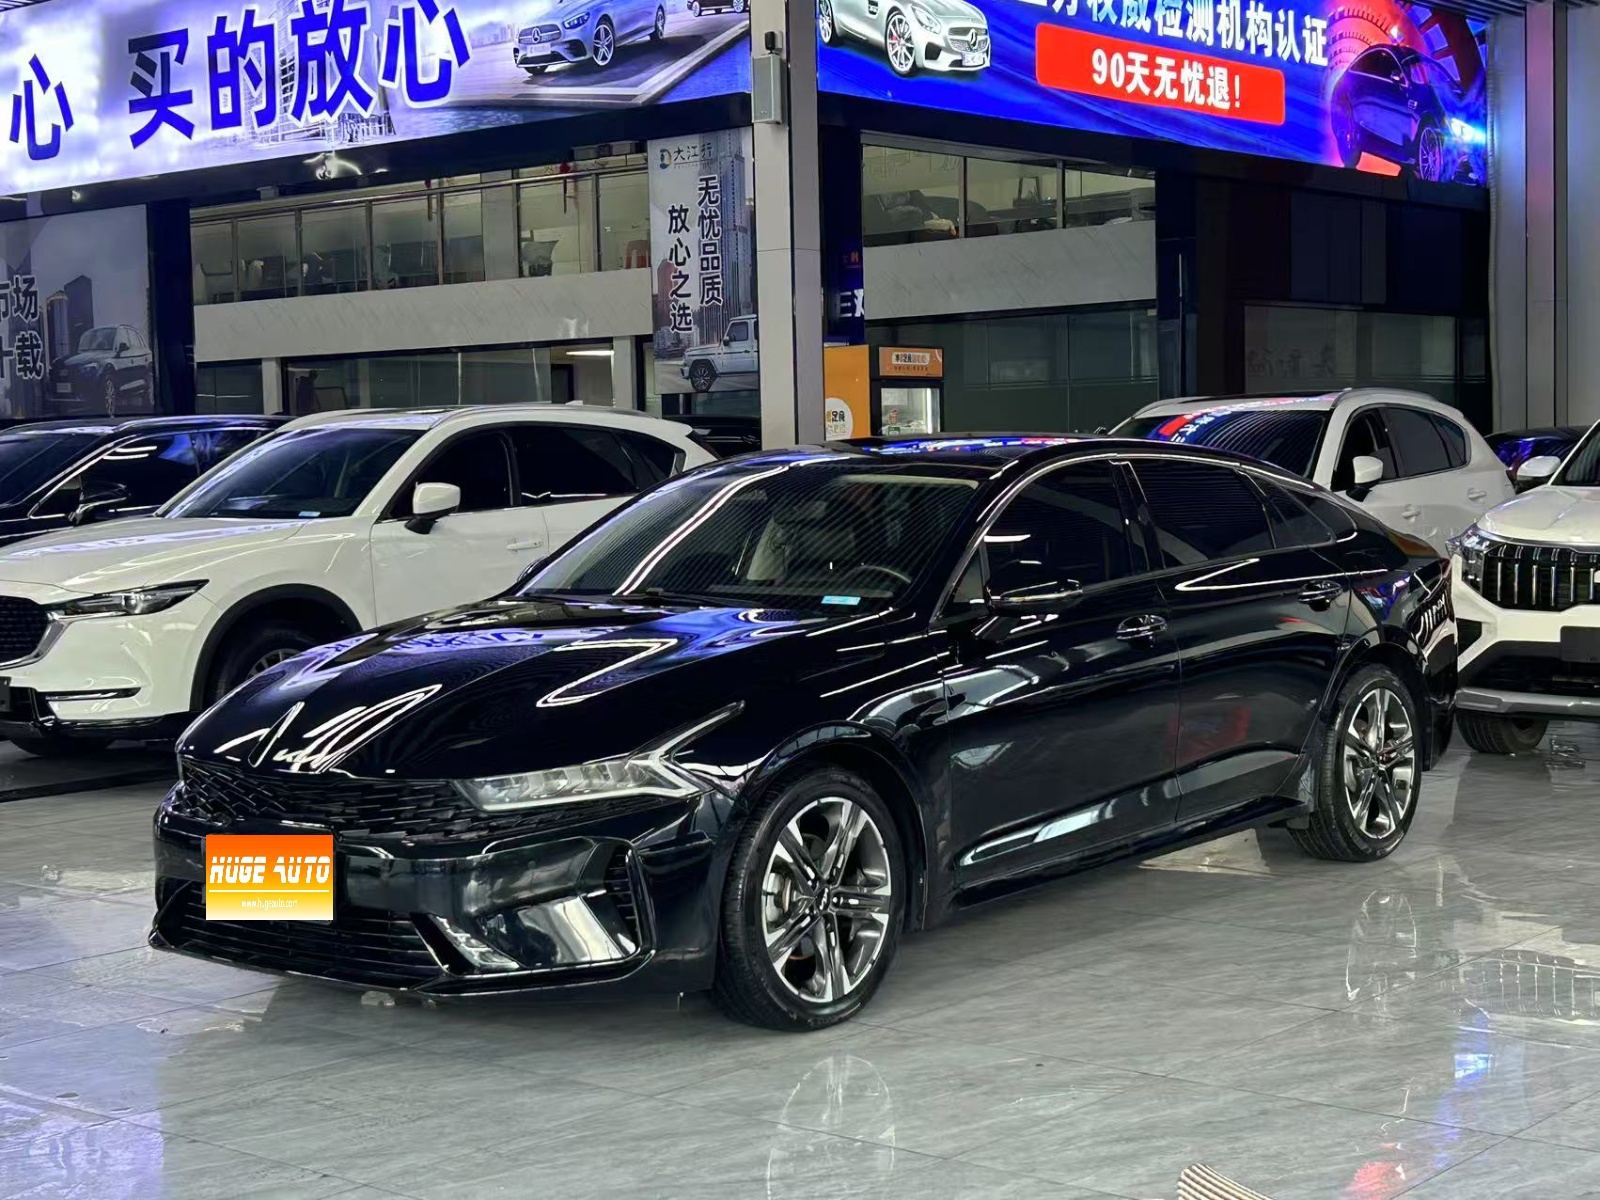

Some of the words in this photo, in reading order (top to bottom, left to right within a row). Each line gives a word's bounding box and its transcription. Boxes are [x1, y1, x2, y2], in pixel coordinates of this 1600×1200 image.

[9, 53, 74, 161] 心
[128, 0, 470, 150] 买的放心
[1012, 0, 1328, 67] 权威检测机构认证
[668, 204, 692, 333] 放心之选
[698, 175, 723, 306] 无忧品质
